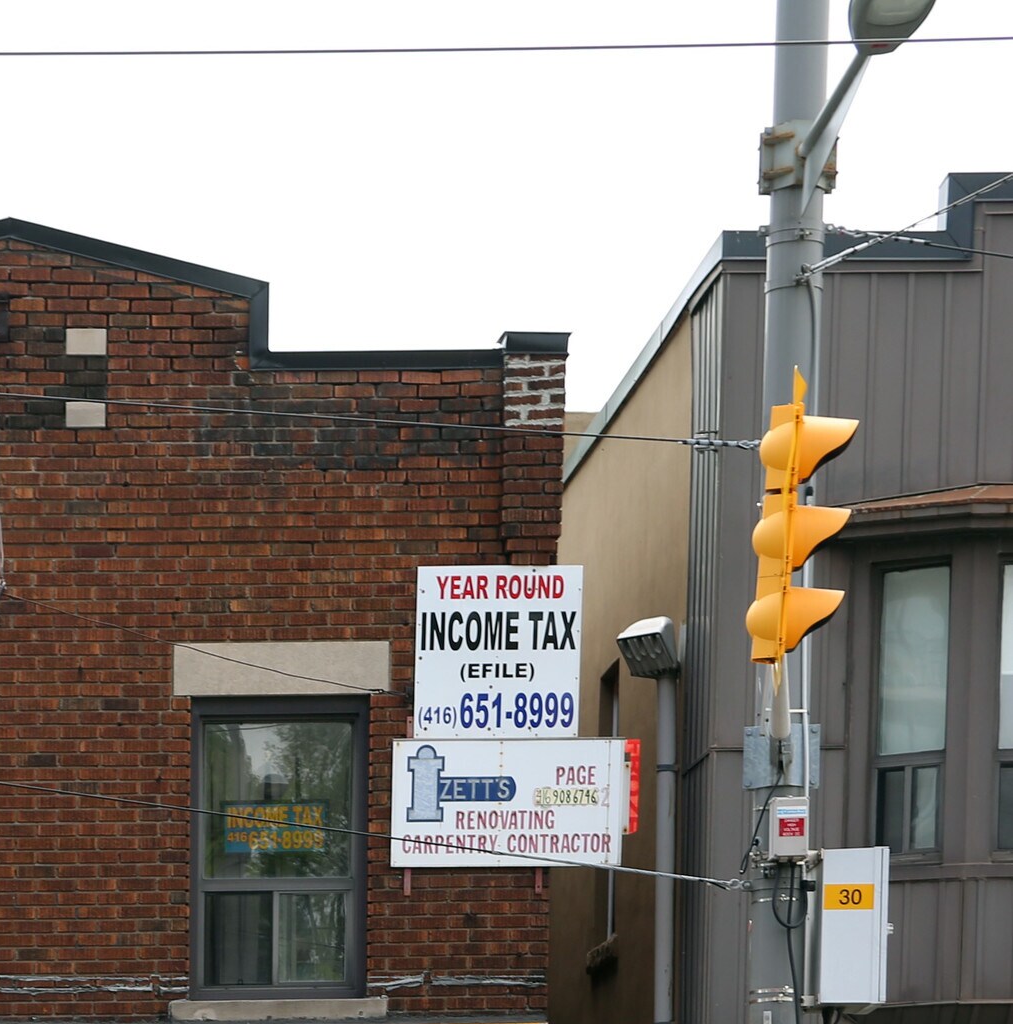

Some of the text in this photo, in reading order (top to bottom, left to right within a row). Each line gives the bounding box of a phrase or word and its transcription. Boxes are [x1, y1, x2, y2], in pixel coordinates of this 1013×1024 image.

[436, 575, 564, 599] YEAR ROUND
[420, 611, 577, 651] INCOME TAX
[460, 663, 535, 682] (EFILE)
[418, 692, 574, 729] (416) 651-8999
[556, 766, 596, 785] PAGE
[227, 805, 323, 828] INCOME TAX
[456, 810, 555, 830] RENOVATING
[402, 833, 611, 855] CARPENTRY CONTRACTOR
[839, 889, 862, 905] 30
